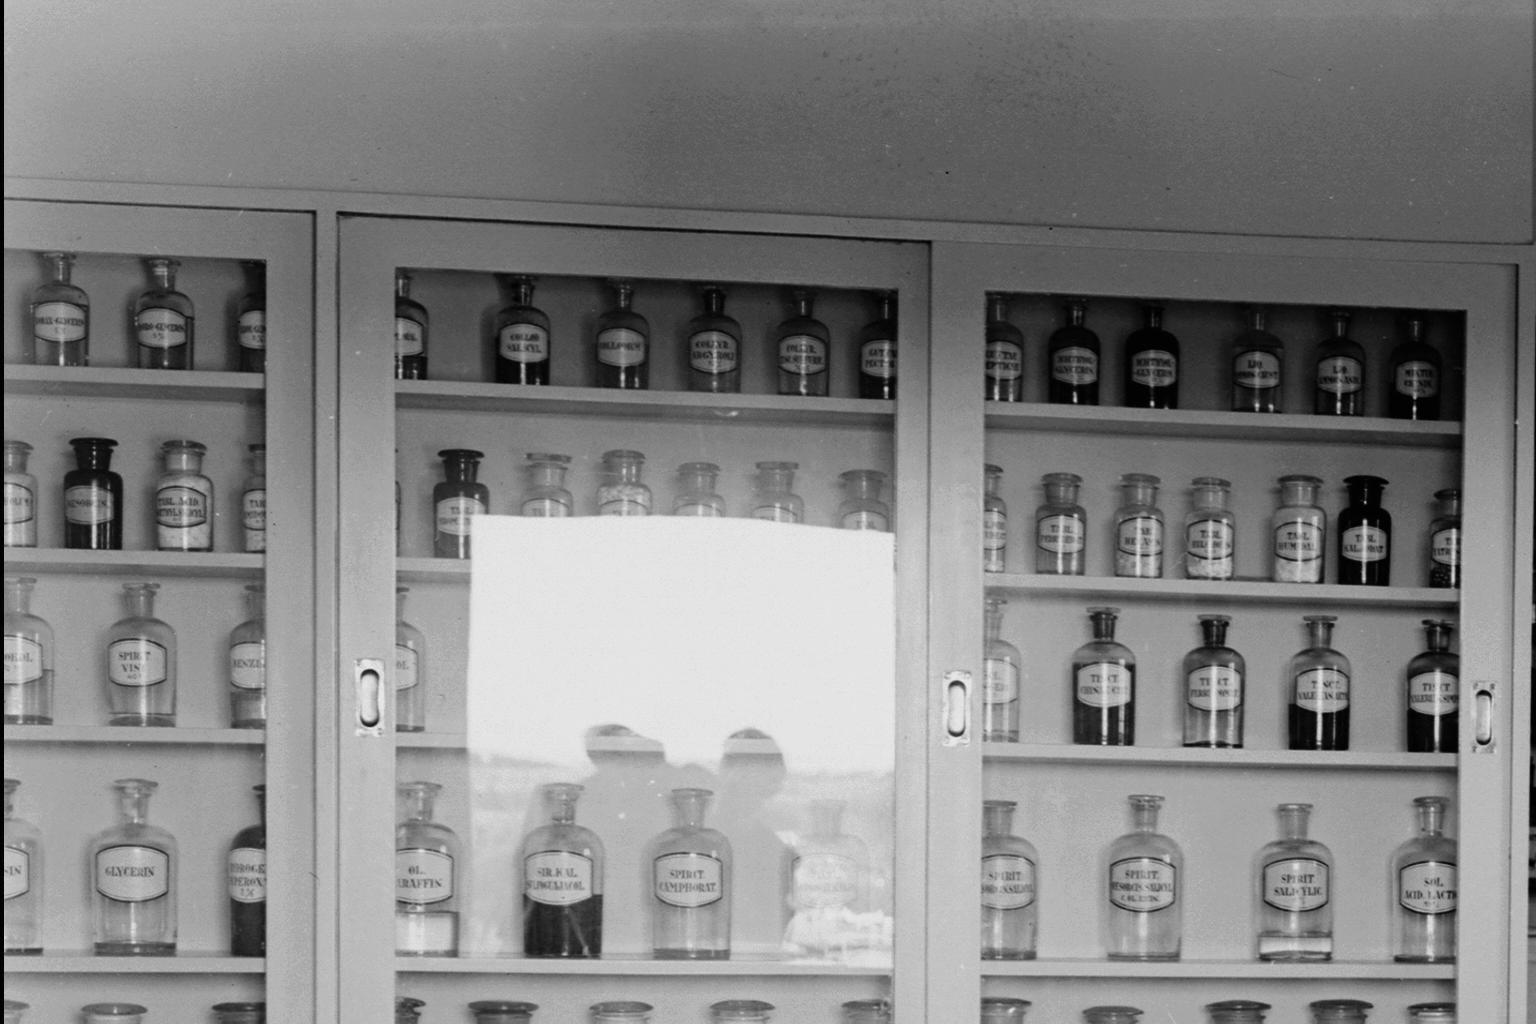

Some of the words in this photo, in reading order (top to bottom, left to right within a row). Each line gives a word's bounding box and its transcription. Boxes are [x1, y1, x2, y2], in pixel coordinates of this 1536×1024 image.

[118, 652, 151, 662] SPIRT
[1089, 674, 1119, 683] TICT
[1199, 677, 1228, 687] TICT
[1310, 680, 1338, 690] TNCT
[1422, 683, 1450, 692] TICT
[105, 866, 154, 878] GLYCERIN
